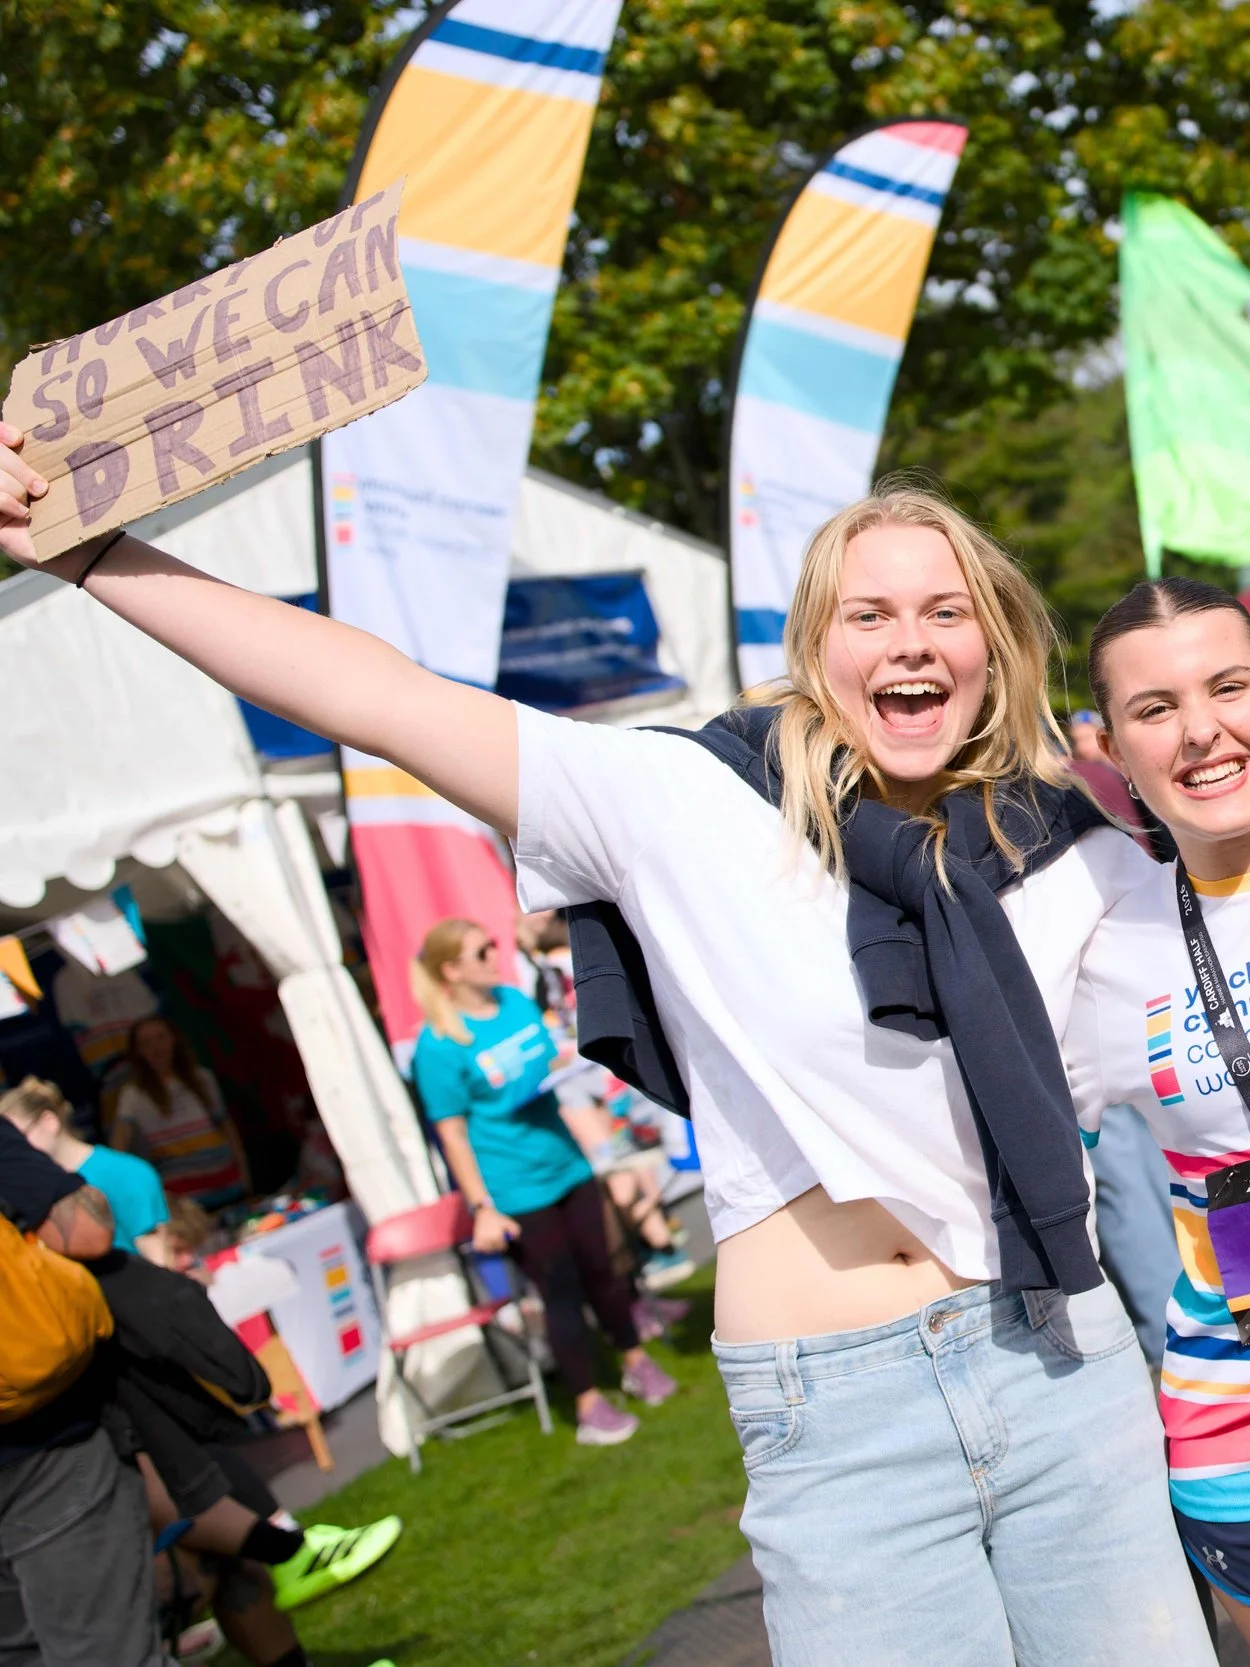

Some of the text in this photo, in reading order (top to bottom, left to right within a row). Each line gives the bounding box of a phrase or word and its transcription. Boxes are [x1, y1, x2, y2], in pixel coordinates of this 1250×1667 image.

[31, 215, 398, 443] SO WE CAN
[65, 298, 422, 528] DRINK
[1180, 884, 1193, 916] 2026
[1187, 937, 1221, 1010] CARDIFF HALF
